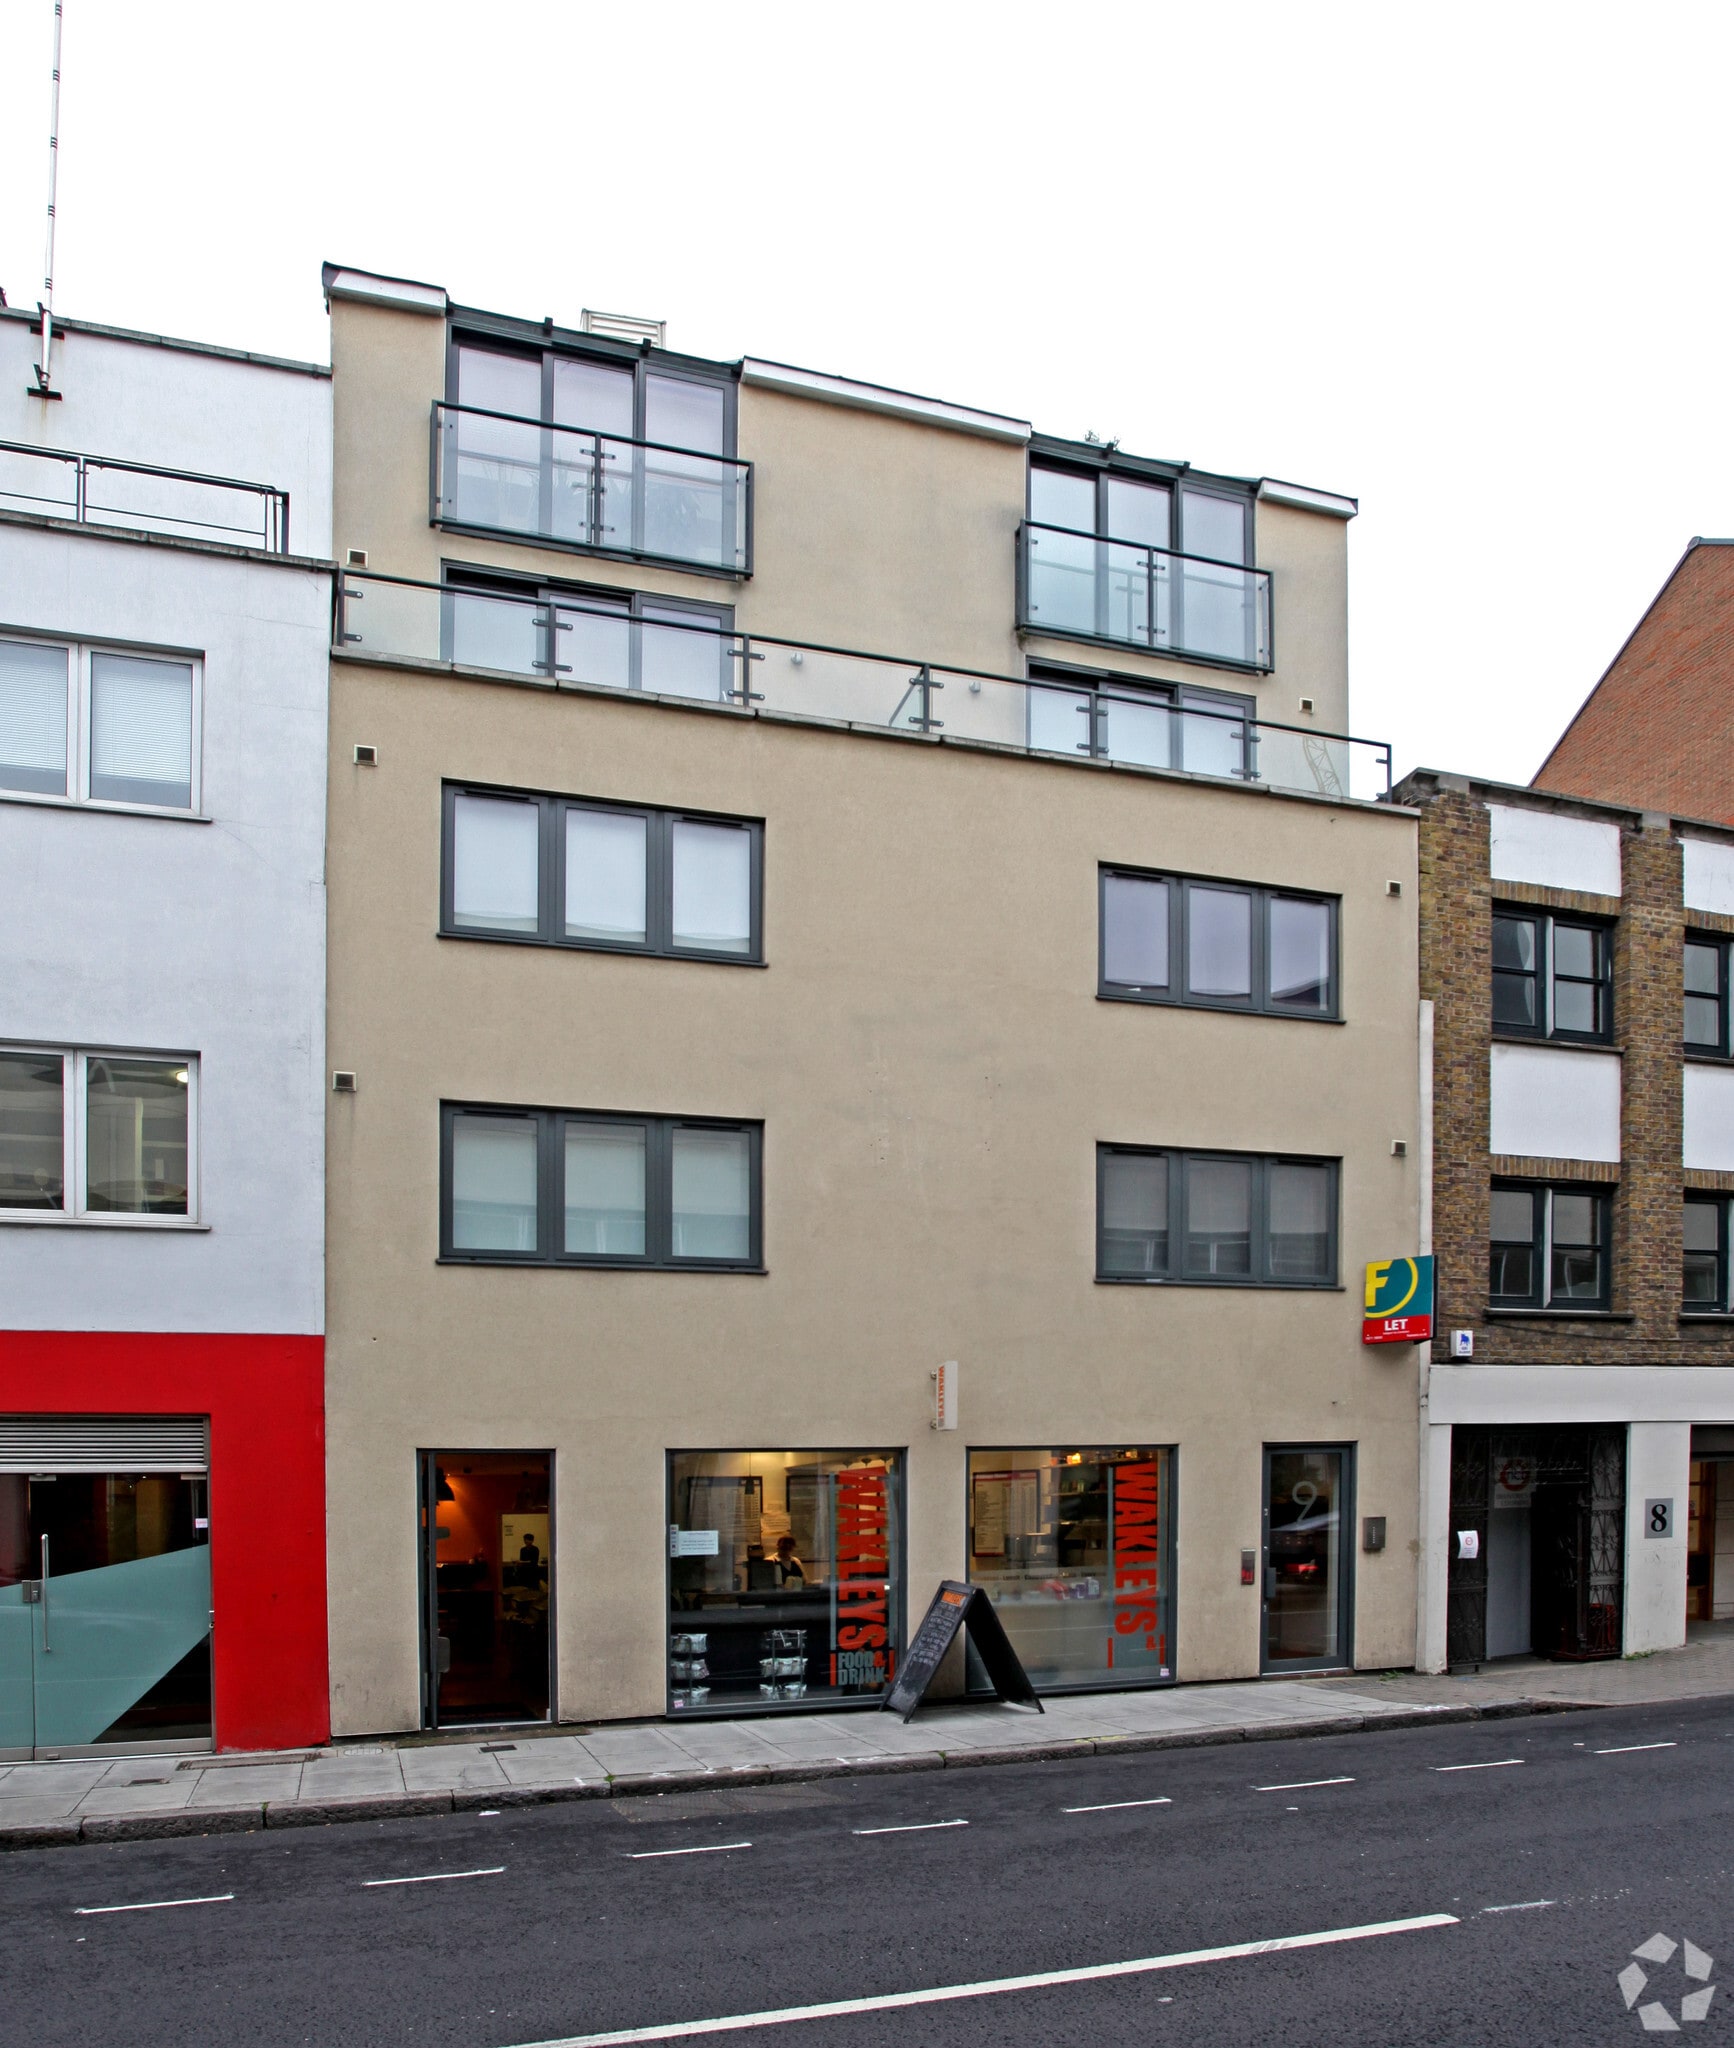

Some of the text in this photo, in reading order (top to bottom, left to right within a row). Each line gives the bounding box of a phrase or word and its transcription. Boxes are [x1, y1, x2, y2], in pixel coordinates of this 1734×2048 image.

[1365, 1260, 1393, 1307] F
[1384, 1319, 1408, 1332] LET
[1292, 1480, 1318, 1523] 9
[1651, 1504, 1667, 1532] 8
[838, 1466, 887, 1650] WAKLEYS
[1115, 1461, 1158, 1635] WAKLEYS
[838, 1651, 874, 1668] FOOD
[838, 1666, 885, 1686] DRINK
